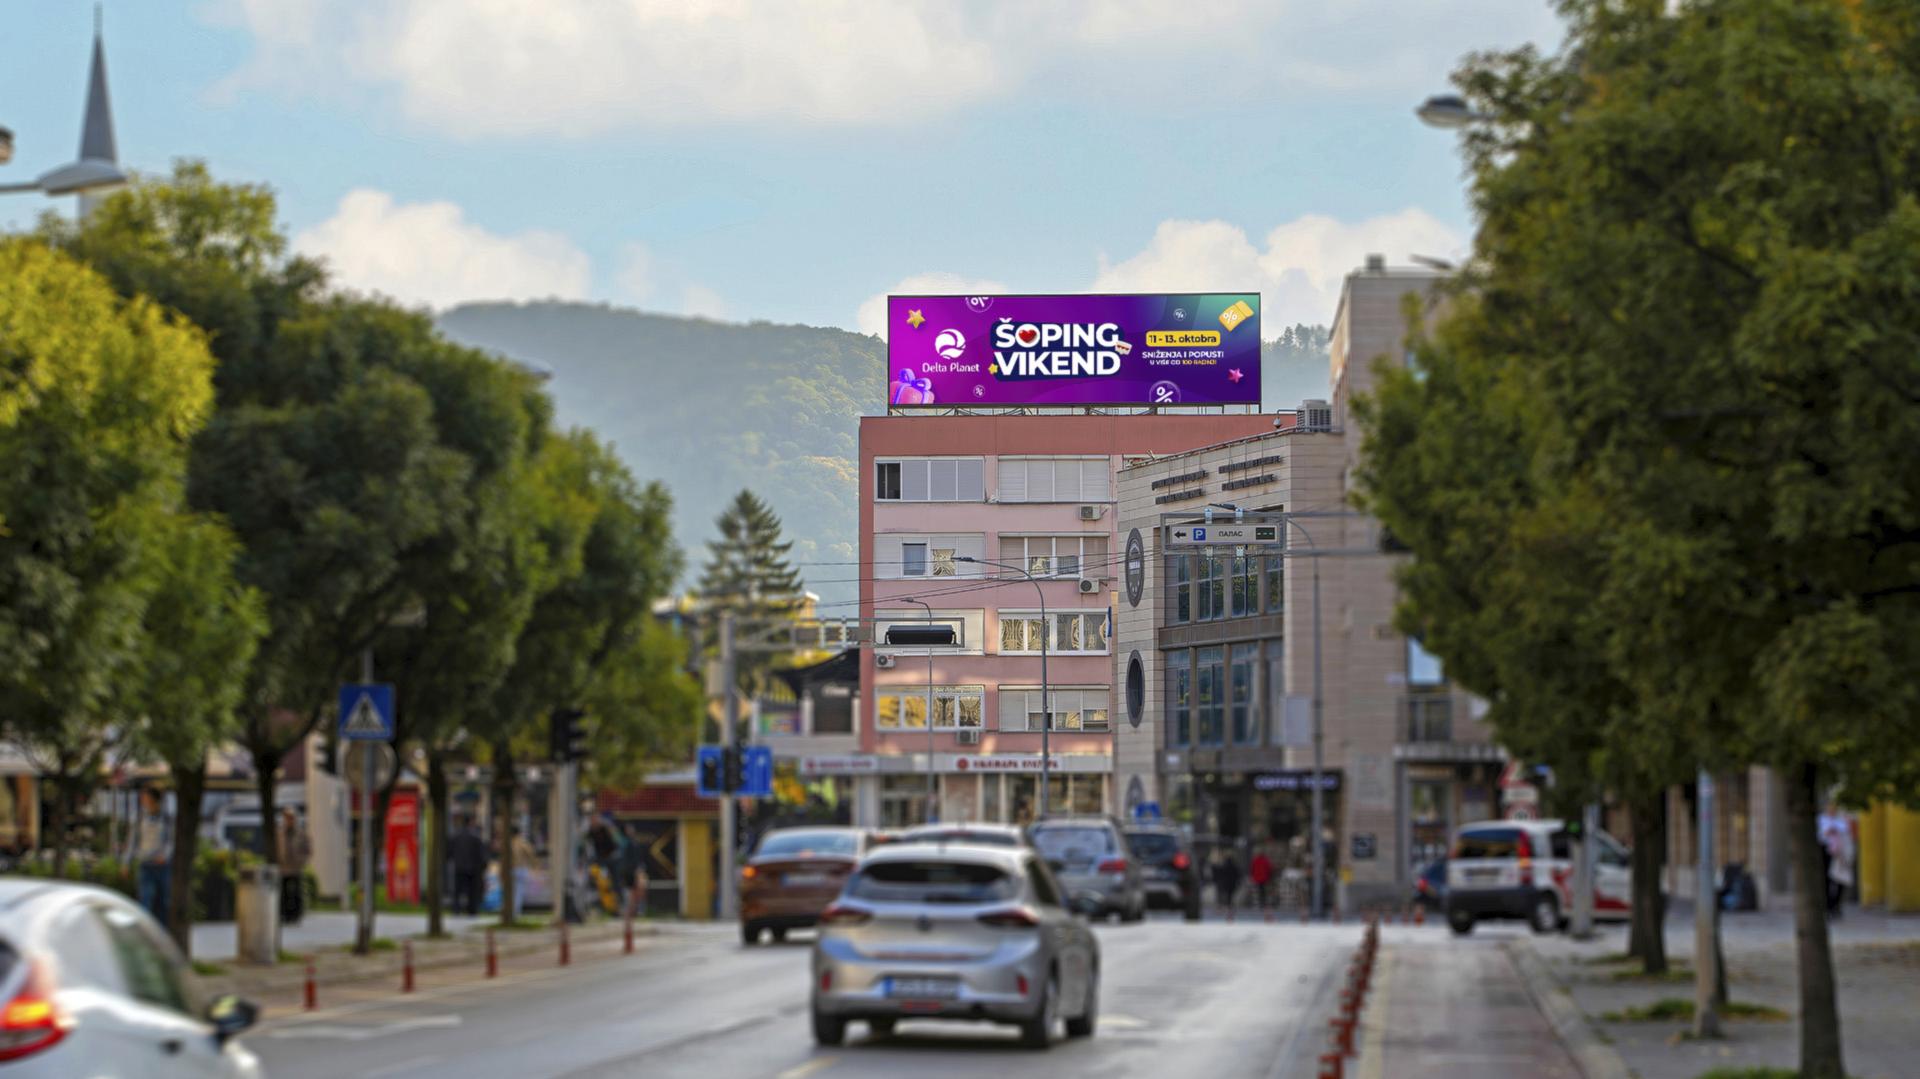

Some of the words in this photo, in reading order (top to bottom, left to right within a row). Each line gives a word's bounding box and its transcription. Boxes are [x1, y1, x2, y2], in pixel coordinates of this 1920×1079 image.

[995, 317, 1119, 348] ŠOPING
[1148, 335, 1157, 343] 11
[1165, 335, 1177, 343] 13.
[1178, 334, 1217, 343] oktobra
[1142, 350, 1183, 359] SNIŽENJA
[1188, 350, 1225, 359] POPUSTI
[922, 362, 947, 373] Delta
[950, 362, 980, 373] Planet
[994, 351, 1121, 376] VIKEND
[1195, 529, 1204, 539] P
[1218, 530, 1244, 538] ПАЛАС
